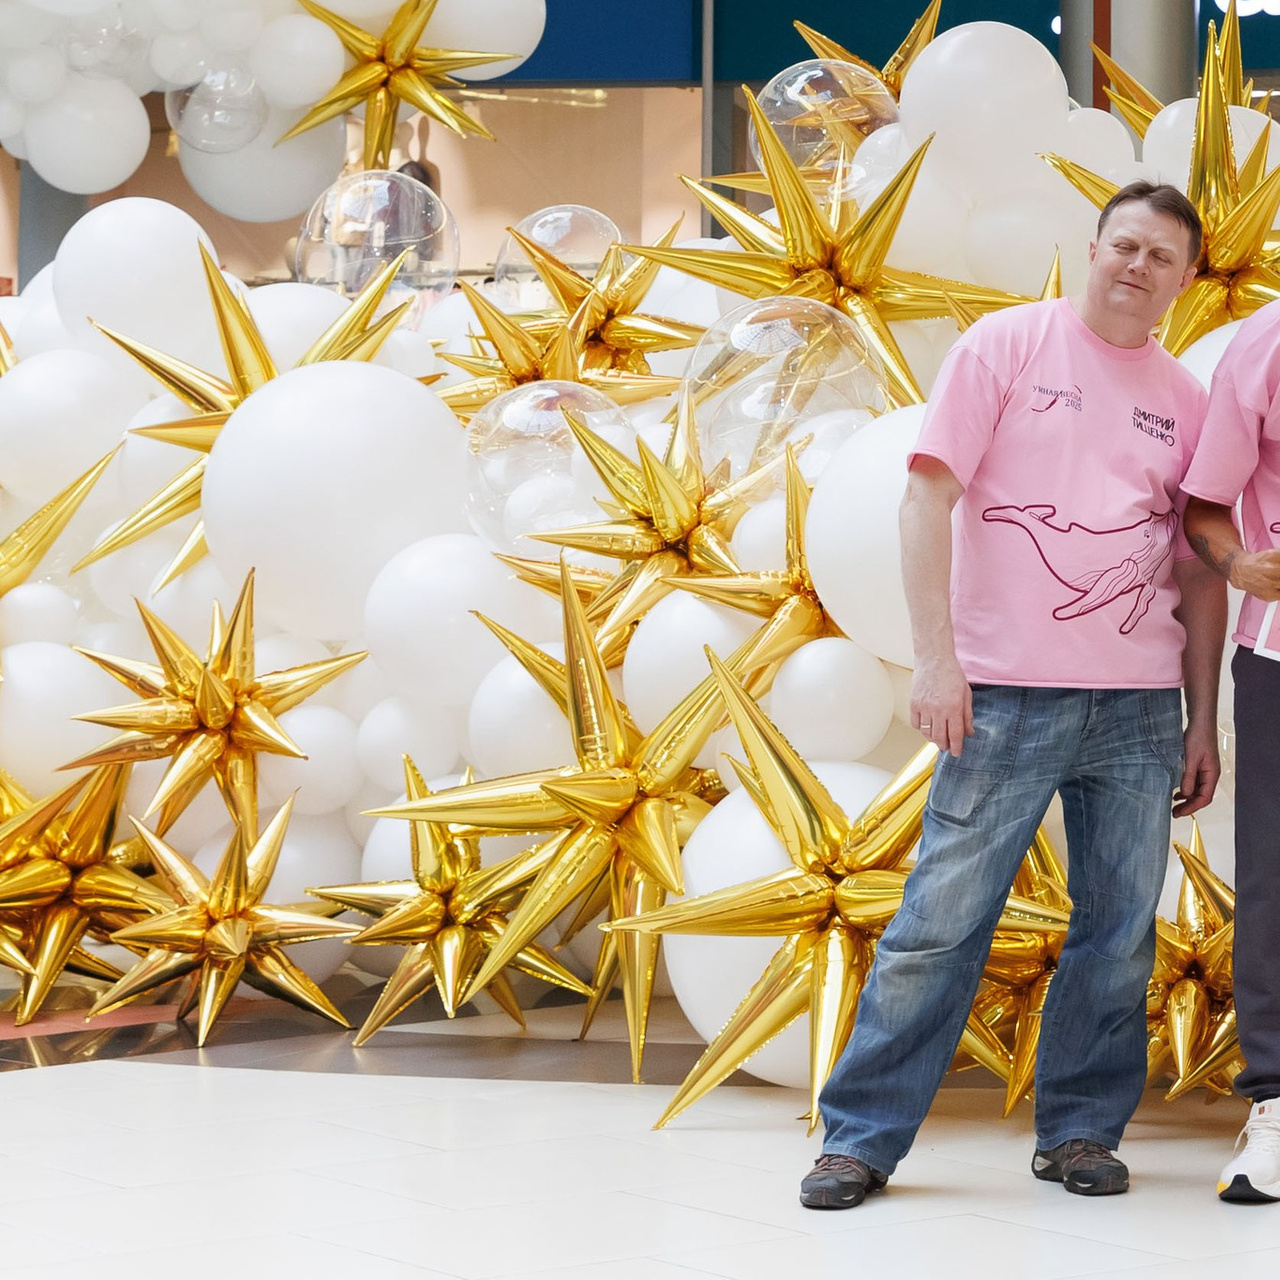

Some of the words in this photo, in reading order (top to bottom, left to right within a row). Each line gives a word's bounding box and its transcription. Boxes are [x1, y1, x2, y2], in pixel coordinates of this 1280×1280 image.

[1033, 385, 1059, 397] УМНАЯ
[1060, 390, 1082, 403] ВЕСНА
[1064, 398, 1083, 412] 2025
[1133, 406, 1176, 432] ДМИТРИЙ
[1131, 416, 1176, 447] ТИЩЕНКО
